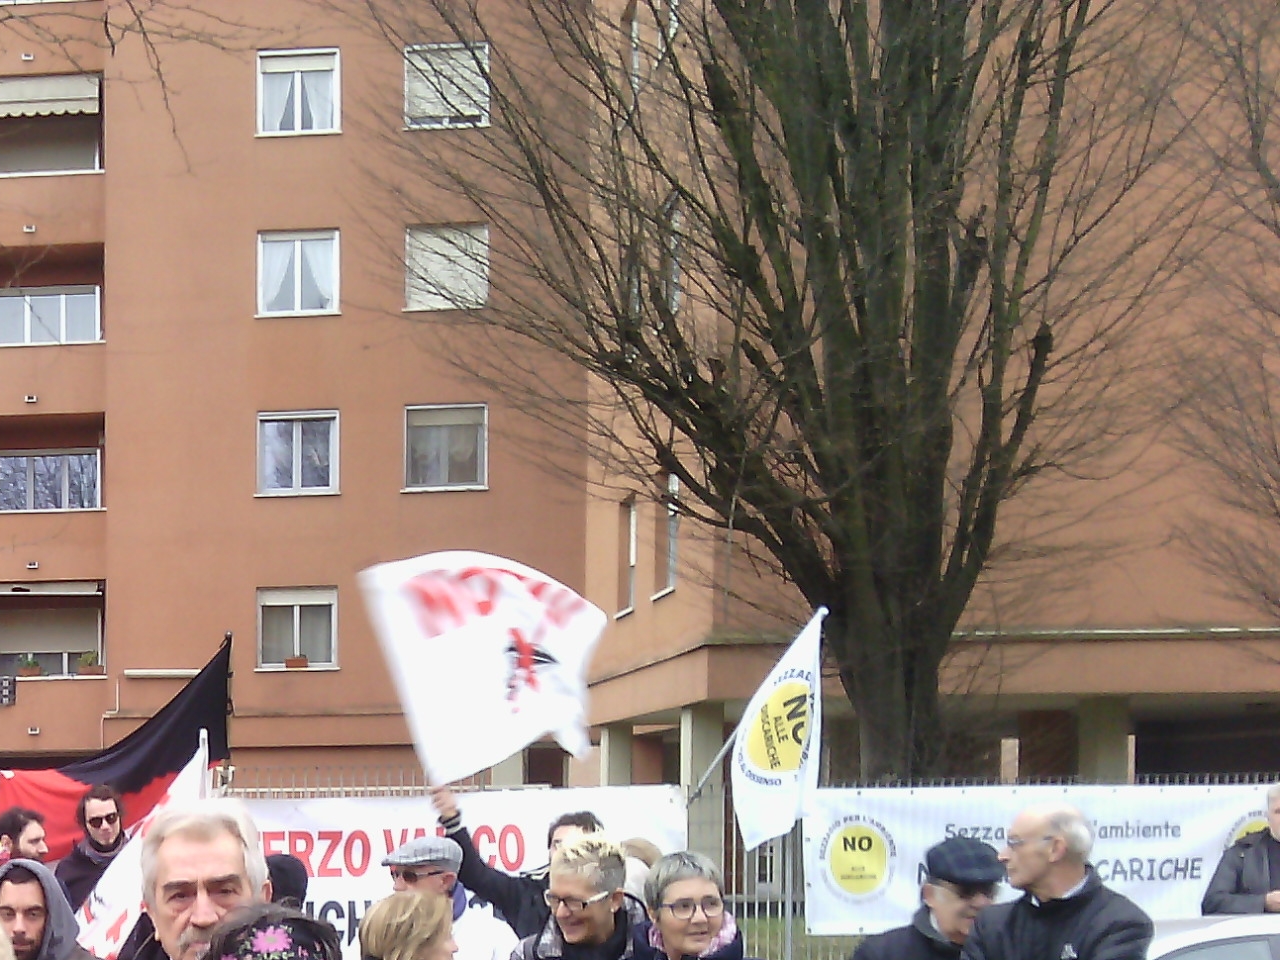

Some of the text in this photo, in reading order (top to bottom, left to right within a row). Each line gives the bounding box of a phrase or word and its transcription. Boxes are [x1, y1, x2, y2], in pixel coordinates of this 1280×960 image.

[944, 819, 1182, 840] Sezza 'ambiente
[257, 830, 371, 876] ERZO
[842, 835, 873, 852] NO
[1094, 857, 1203, 882] CARICHE
